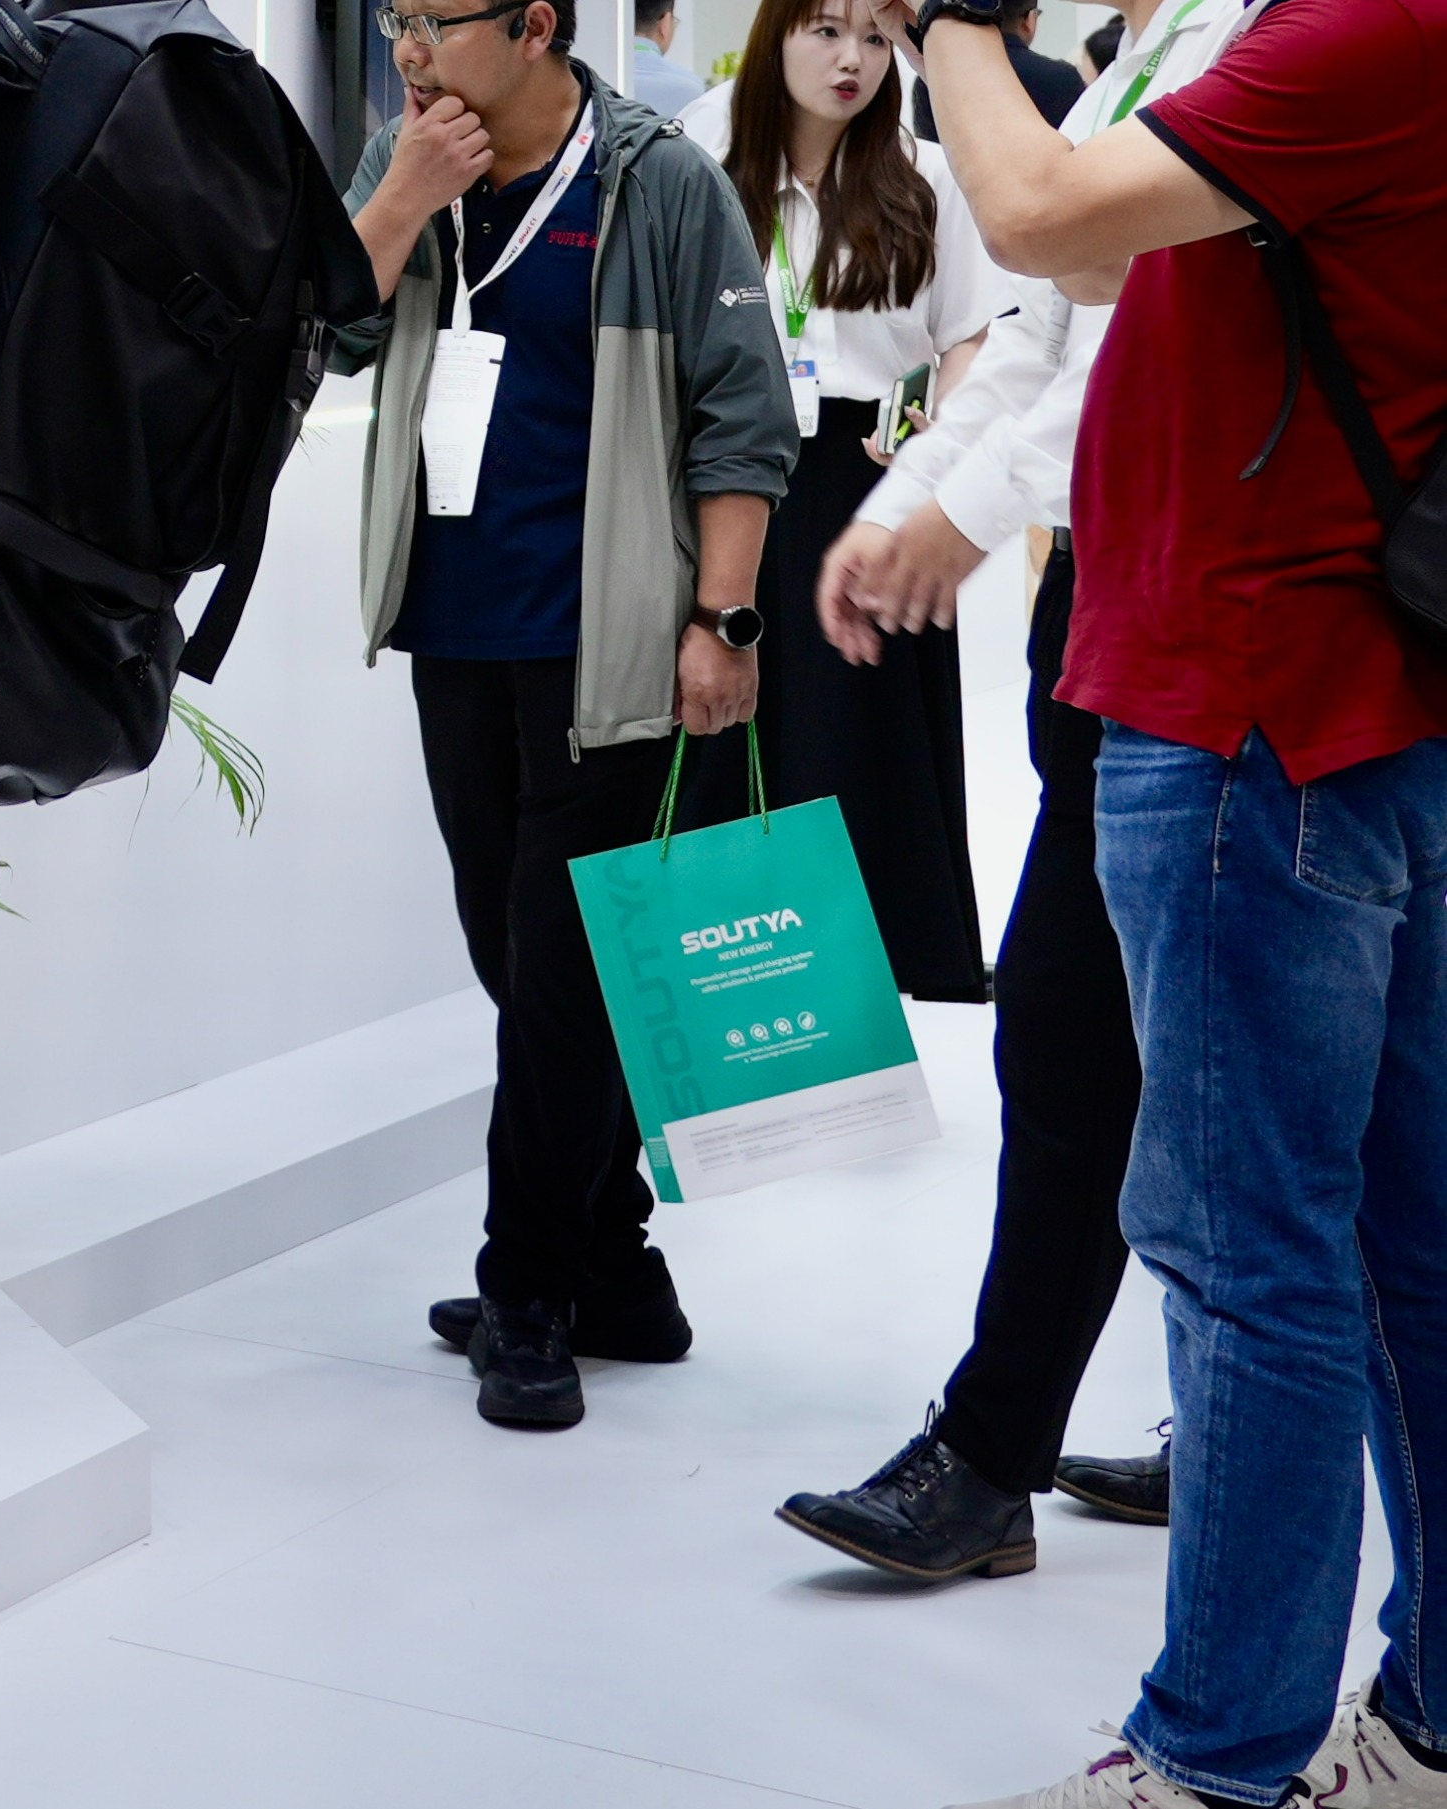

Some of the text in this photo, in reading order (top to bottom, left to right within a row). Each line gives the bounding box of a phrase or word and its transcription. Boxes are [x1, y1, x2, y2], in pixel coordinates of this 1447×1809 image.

[680, 908, 804, 955] SOUTYA
[718, 941, 774, 962] NEW ENERGY
